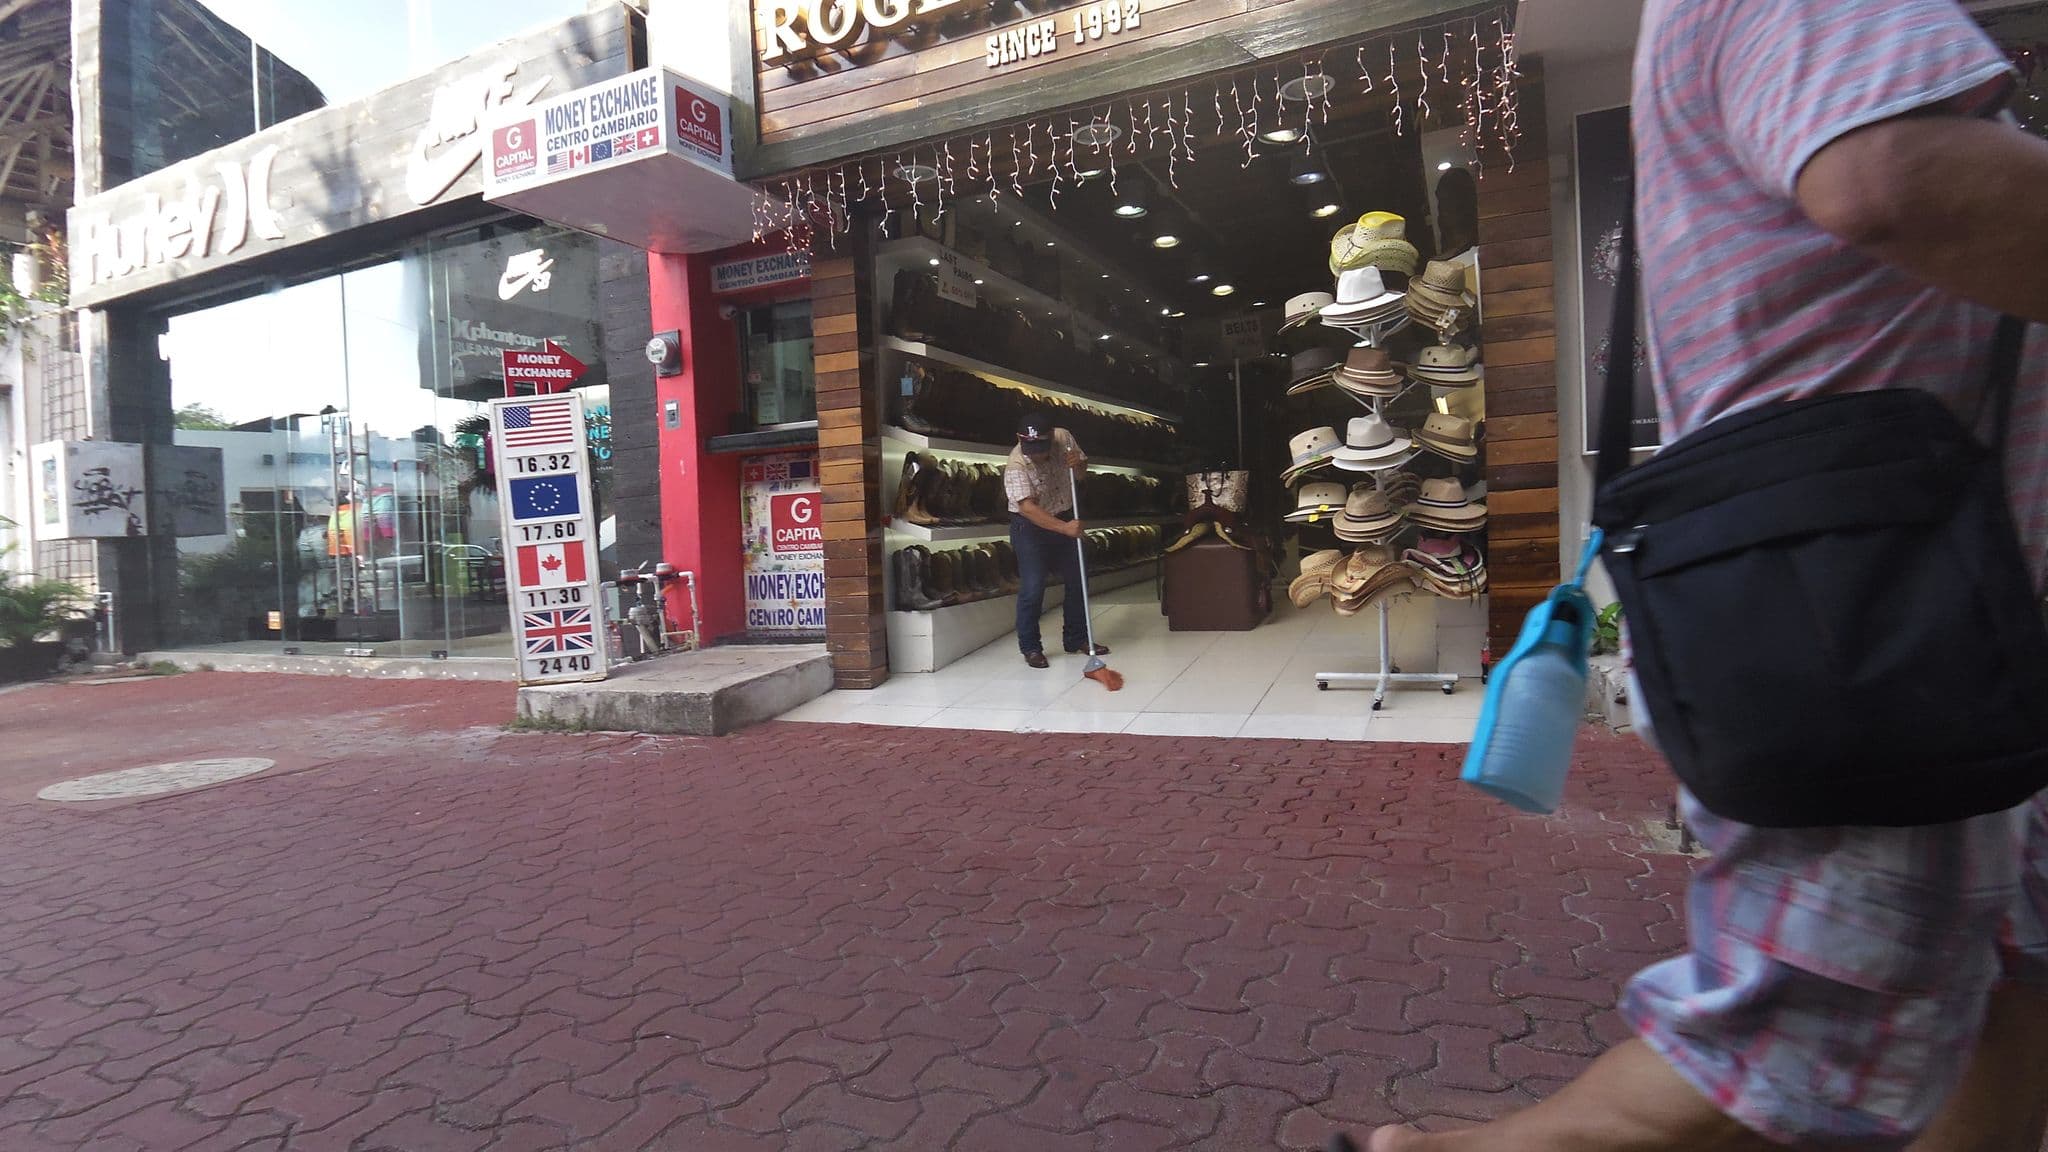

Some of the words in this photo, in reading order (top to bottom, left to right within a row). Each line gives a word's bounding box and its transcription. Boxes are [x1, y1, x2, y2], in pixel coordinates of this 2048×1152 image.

[986, 19, 1057, 67] SINCE
[1073, 0, 1140, 44] 1992
[545, 97, 587, 136] MONEY
[590, 75, 658, 123] EXCHANGE
[691, 99, 706, 123] G
[506, 126, 522, 151] G
[547, 128, 589, 152] CENTRO
[592, 108, 658, 139] CAMBIARIO
[680, 118, 719, 147] CAPITAL
[495, 148, 536, 169] CAPITAL
[717, 262, 754, 282] MONEY
[517, 354, 561, 365] MONEY
[507, 367, 572, 378] EXCHANGE
[517, 455, 570, 473] 16.32
[790, 497, 812, 523] G
[522, 522, 575, 541] 17.60
[528, 588, 580, 607] 11.30
[748, 573, 792, 600] MONEY
[749, 608, 794, 626] CENTRO
[797, 608, 826, 626] CAM
